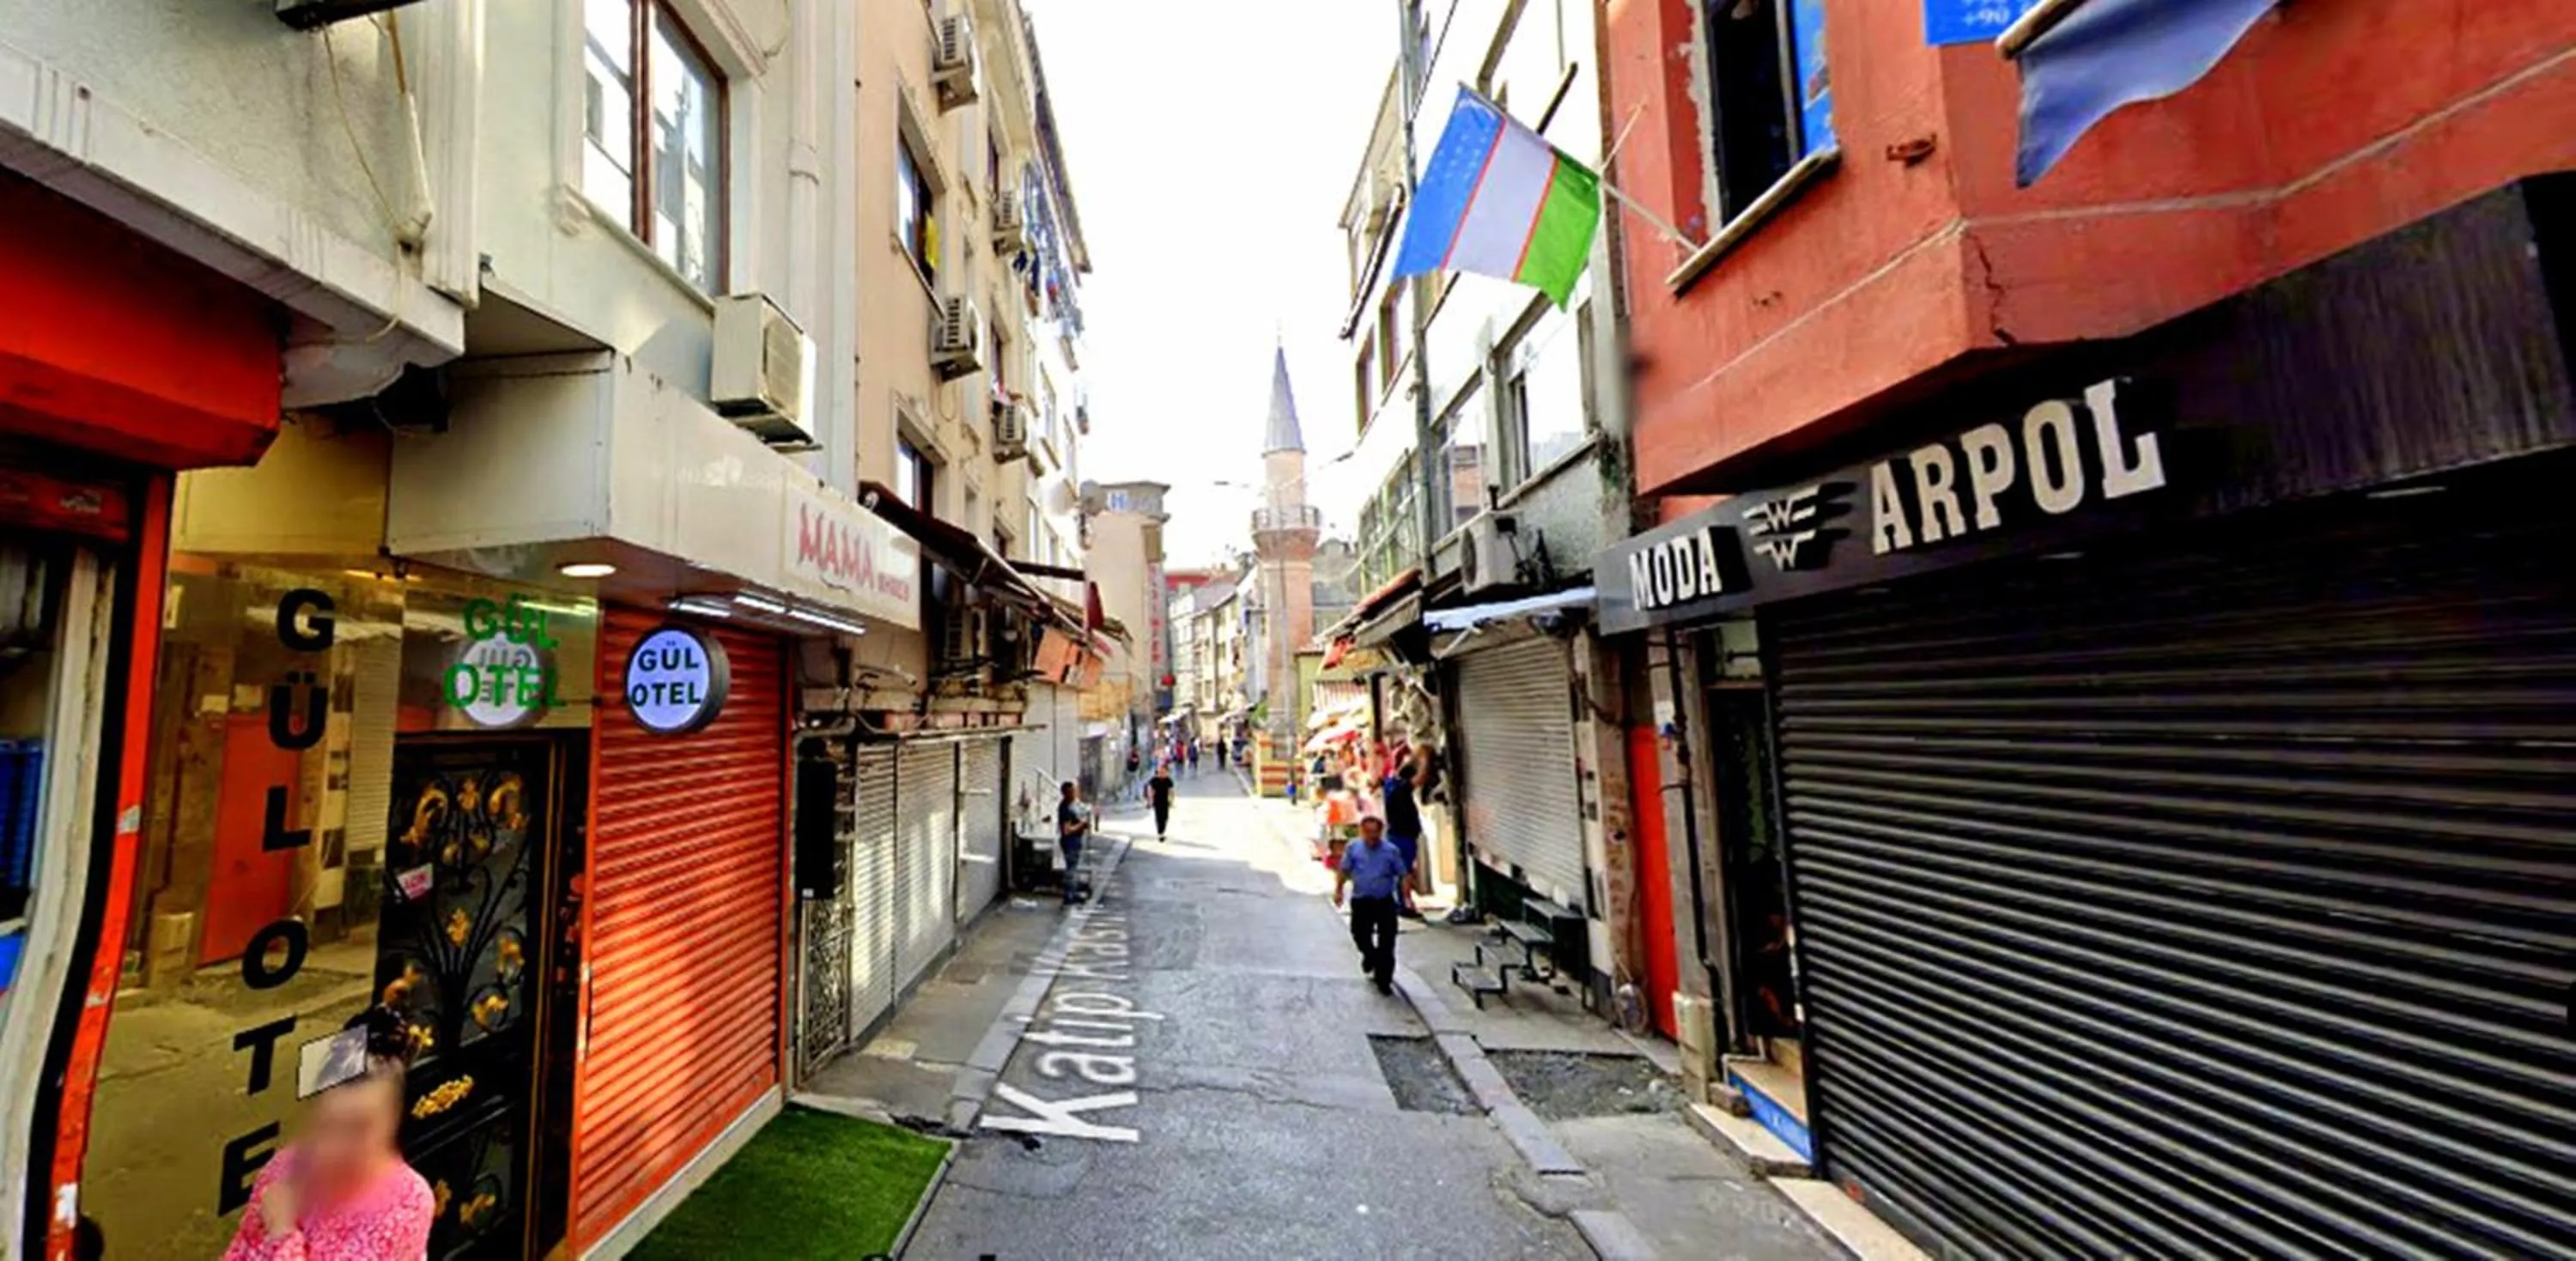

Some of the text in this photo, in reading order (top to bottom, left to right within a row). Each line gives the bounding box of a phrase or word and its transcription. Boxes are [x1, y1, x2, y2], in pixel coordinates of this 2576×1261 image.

[1630, 379, 2166, 612] MODA ARPOL
[798, 502, 874, 591] MAMA
[464, 592, 559, 649] GÜL
[637, 640, 700, 672] GÜL
[443, 663, 568, 711] OTEL
[630, 682, 702, 707] OTEL
[217, 919, 313, 1217] OTE
